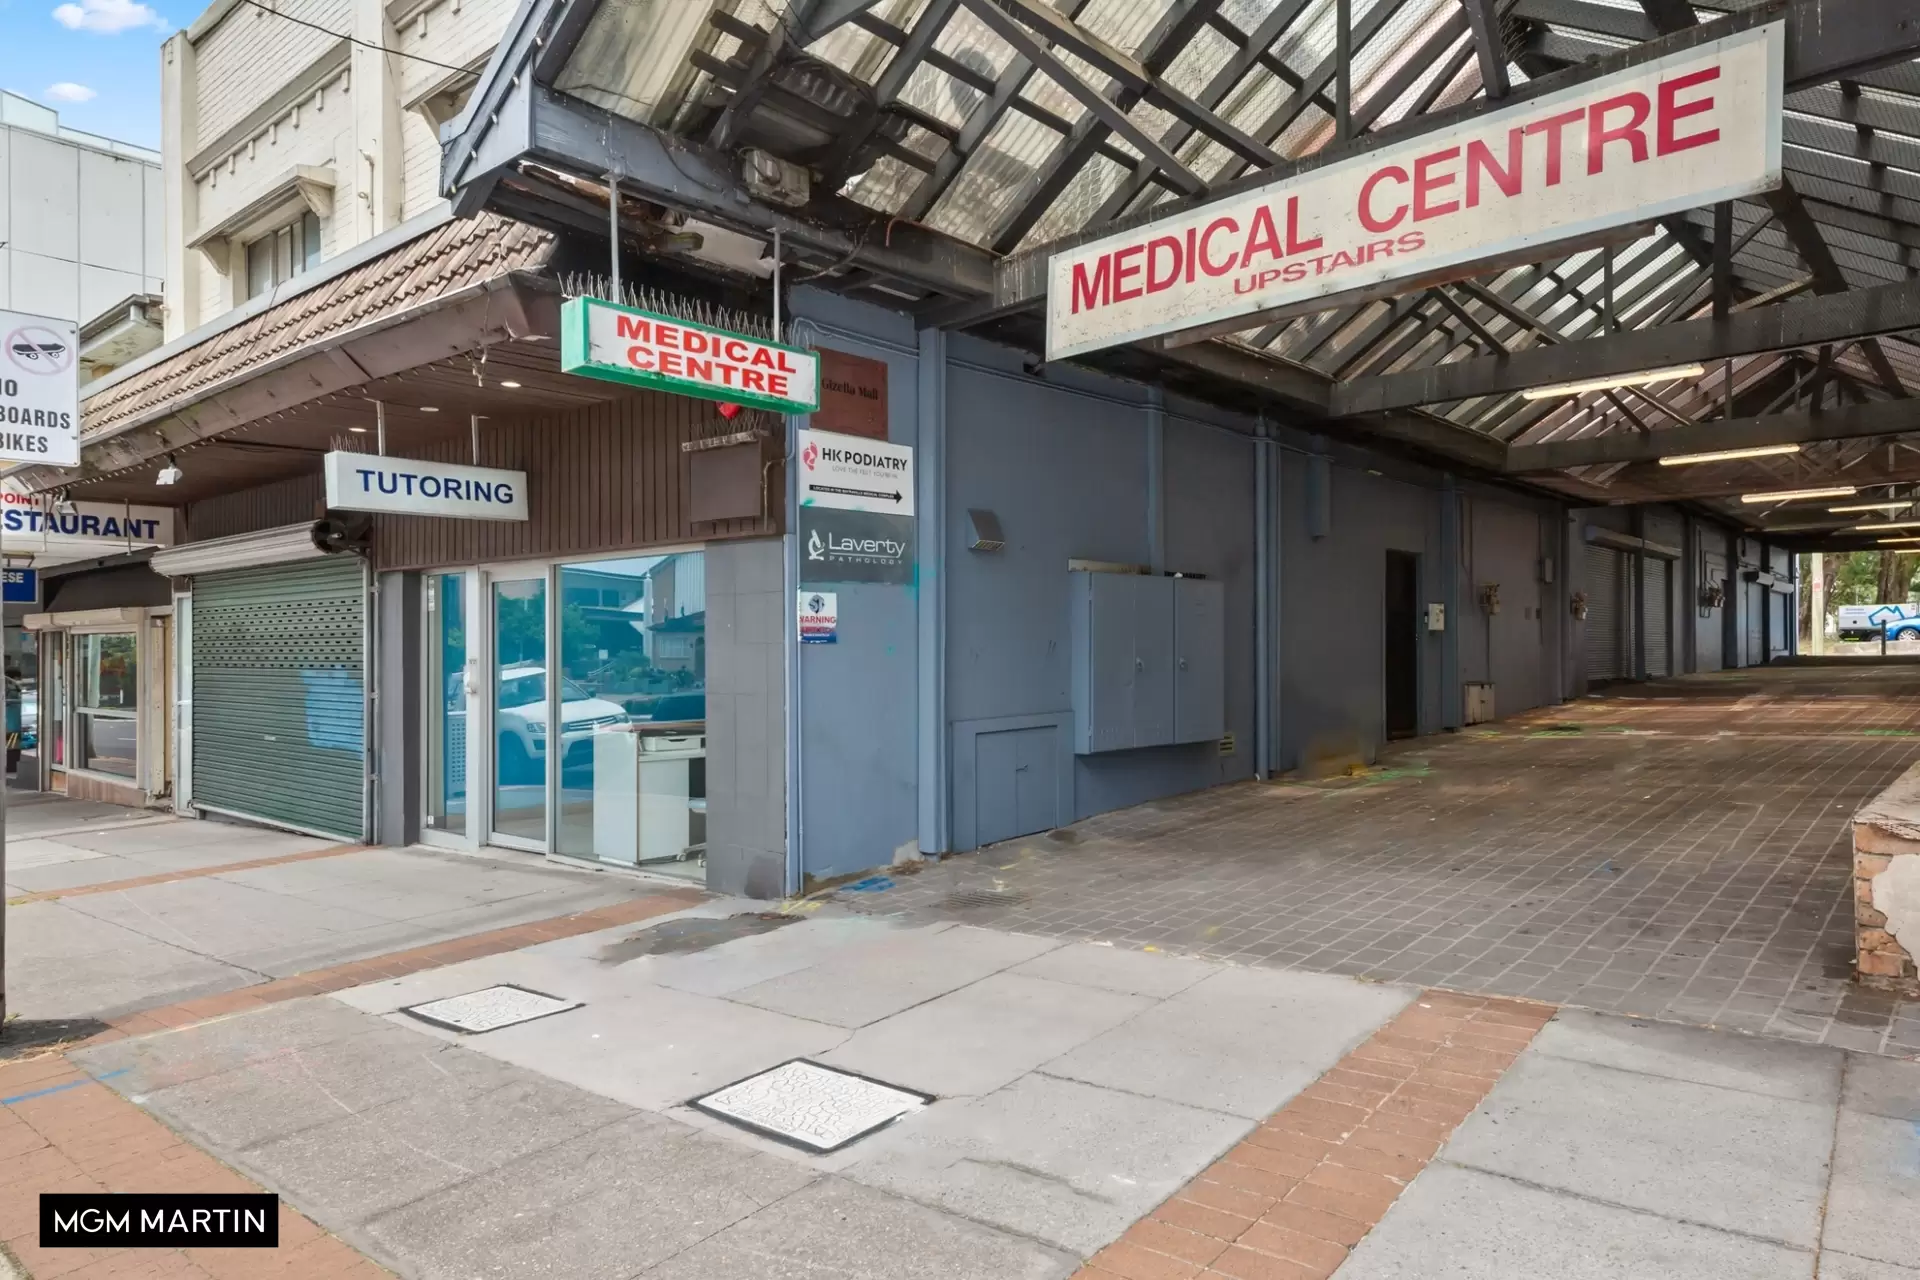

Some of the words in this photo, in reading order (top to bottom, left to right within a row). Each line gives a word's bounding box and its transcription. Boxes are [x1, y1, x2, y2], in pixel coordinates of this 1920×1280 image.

[1071, 196, 1323, 314] MEDICAL
[1357, 65, 1721, 233] CENTRE
[1233, 231, 1425, 294] UPSTAIRS
[616, 314, 796, 373] MEDICAL
[627, 345, 788, 396] CENTRE
[0, 378, 18, 397] O
[858, 386, 879, 400] Mall
[822, 447, 842, 462] HK
[844, 451, 907, 471] PODIATRY
[356, 469, 514, 504] TUTORING
[0, 508, 160, 540] STAURANT
[828, 531, 906, 558] Laverty
[829, 555, 904, 565] PATHOLOGY
